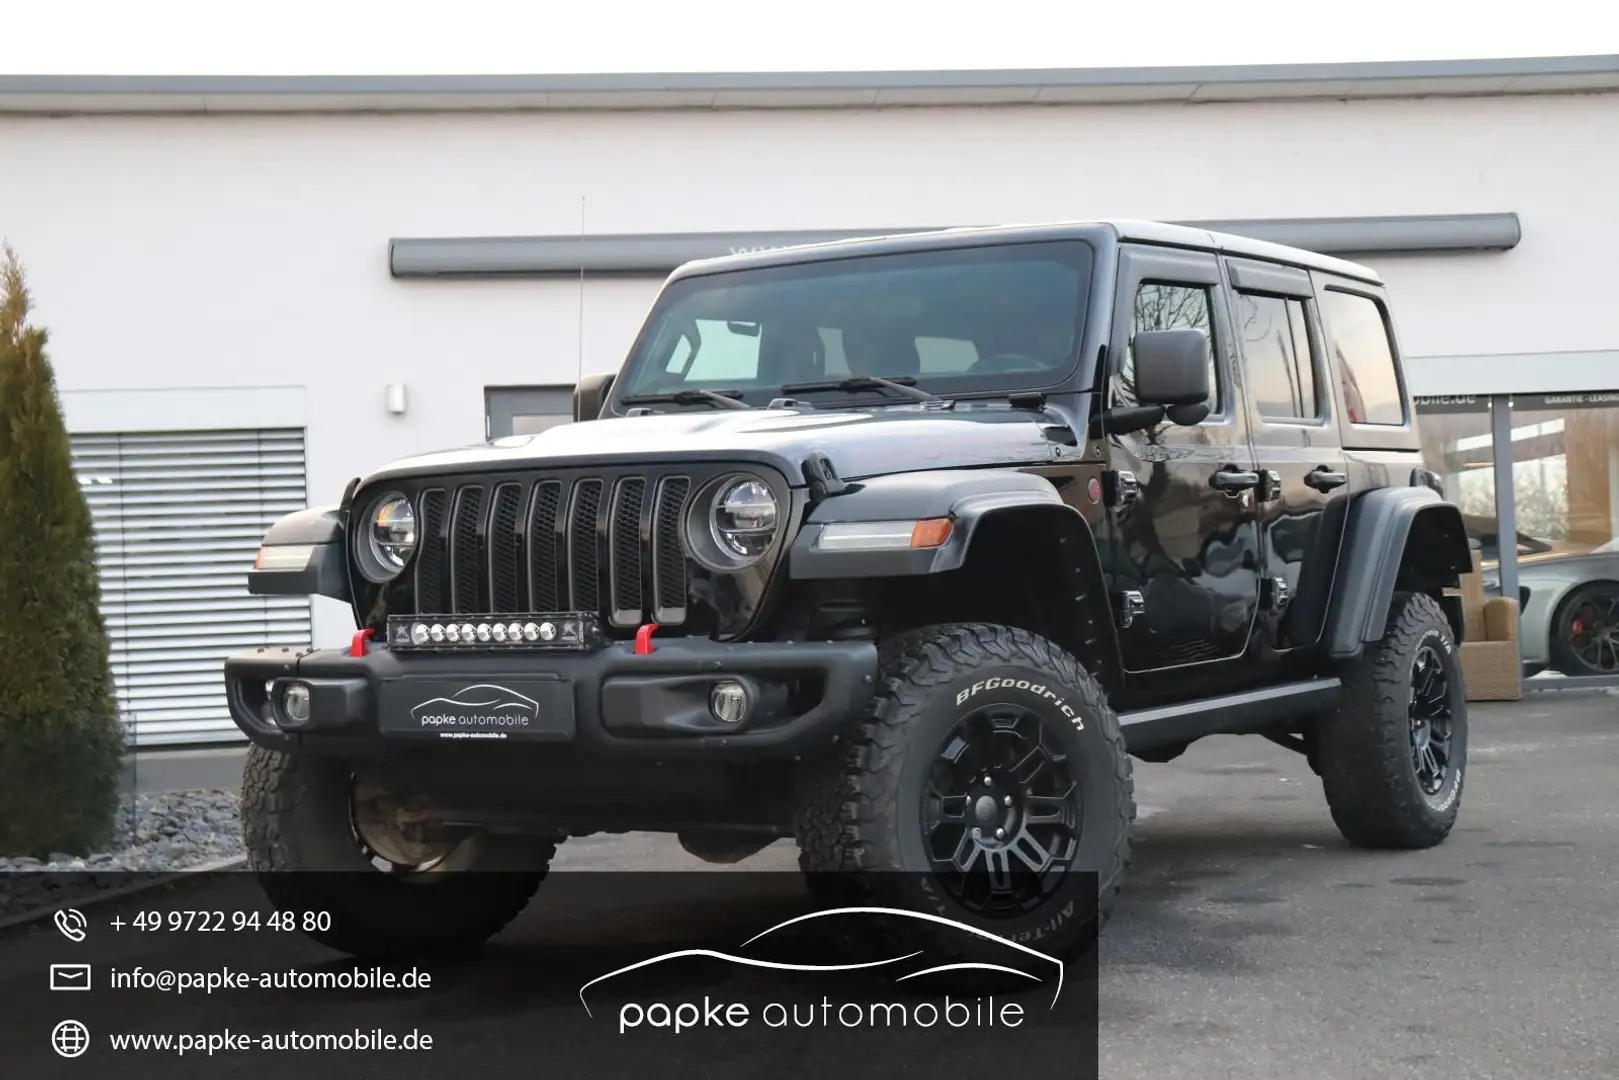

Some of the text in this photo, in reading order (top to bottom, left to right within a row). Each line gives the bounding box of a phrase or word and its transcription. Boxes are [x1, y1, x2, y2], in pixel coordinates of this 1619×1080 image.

[421, 714, 529, 727] papke automobile
[956, 676, 1085, 731] BFGoodrich
